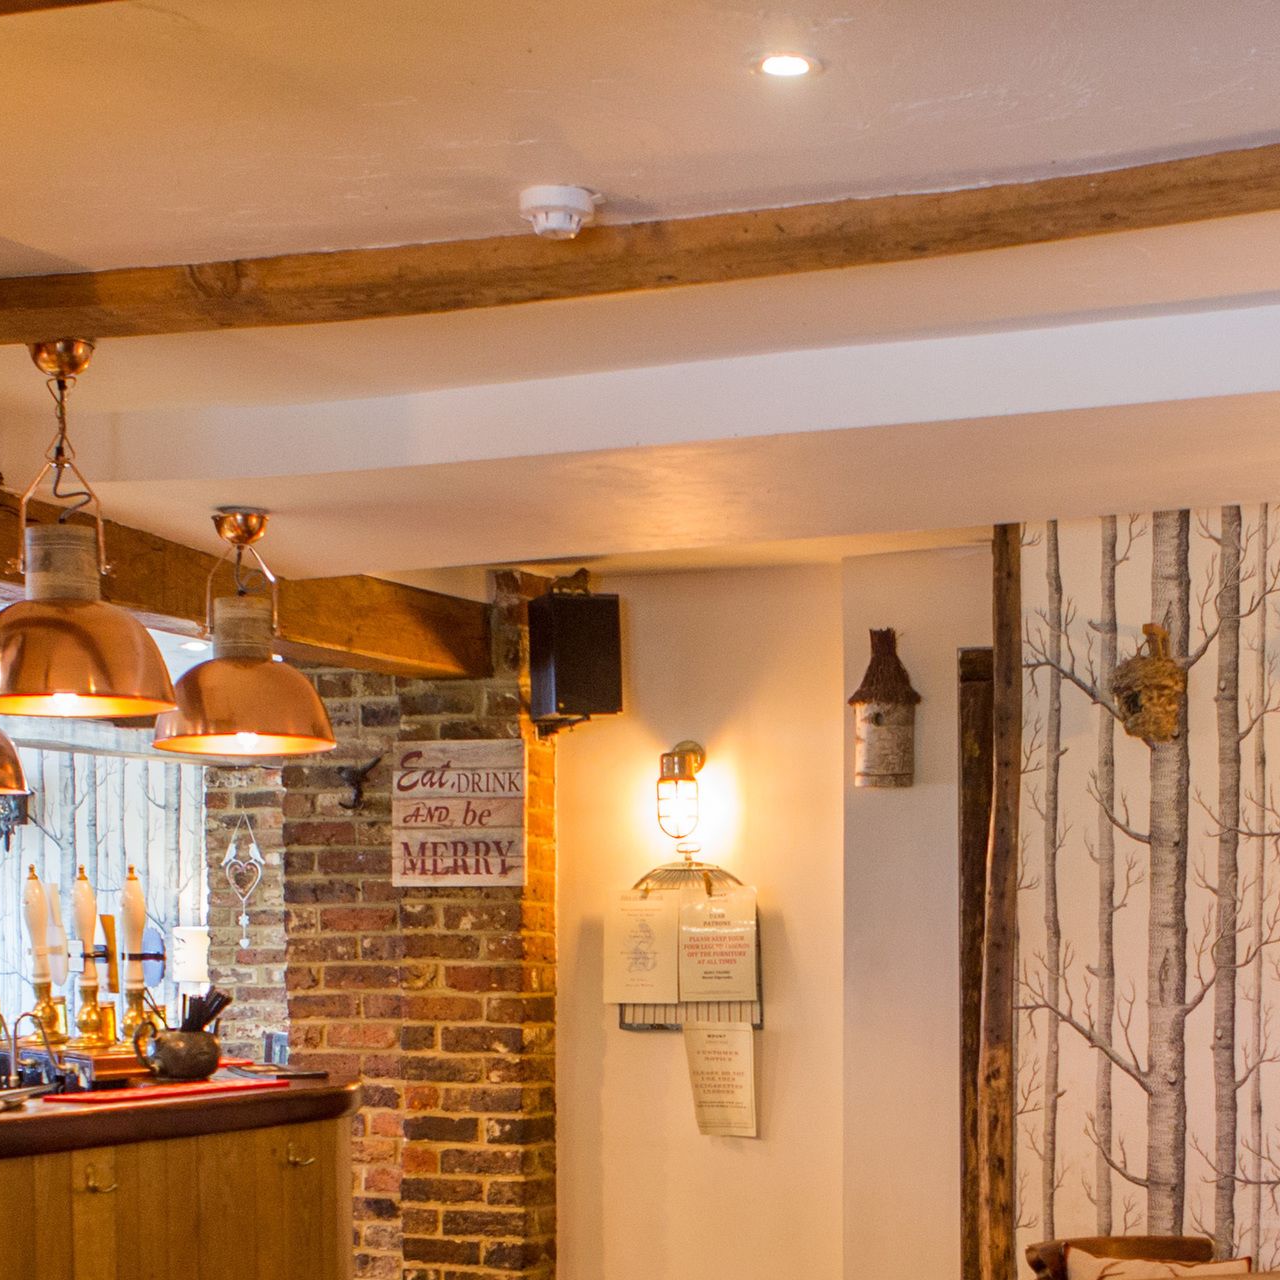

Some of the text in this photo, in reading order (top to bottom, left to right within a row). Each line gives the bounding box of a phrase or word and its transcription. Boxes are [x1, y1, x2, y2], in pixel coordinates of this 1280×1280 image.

[457, 772, 521, 793] DRINK
[462, 801, 491, 826] be
[401, 840, 515, 876] MERRY
